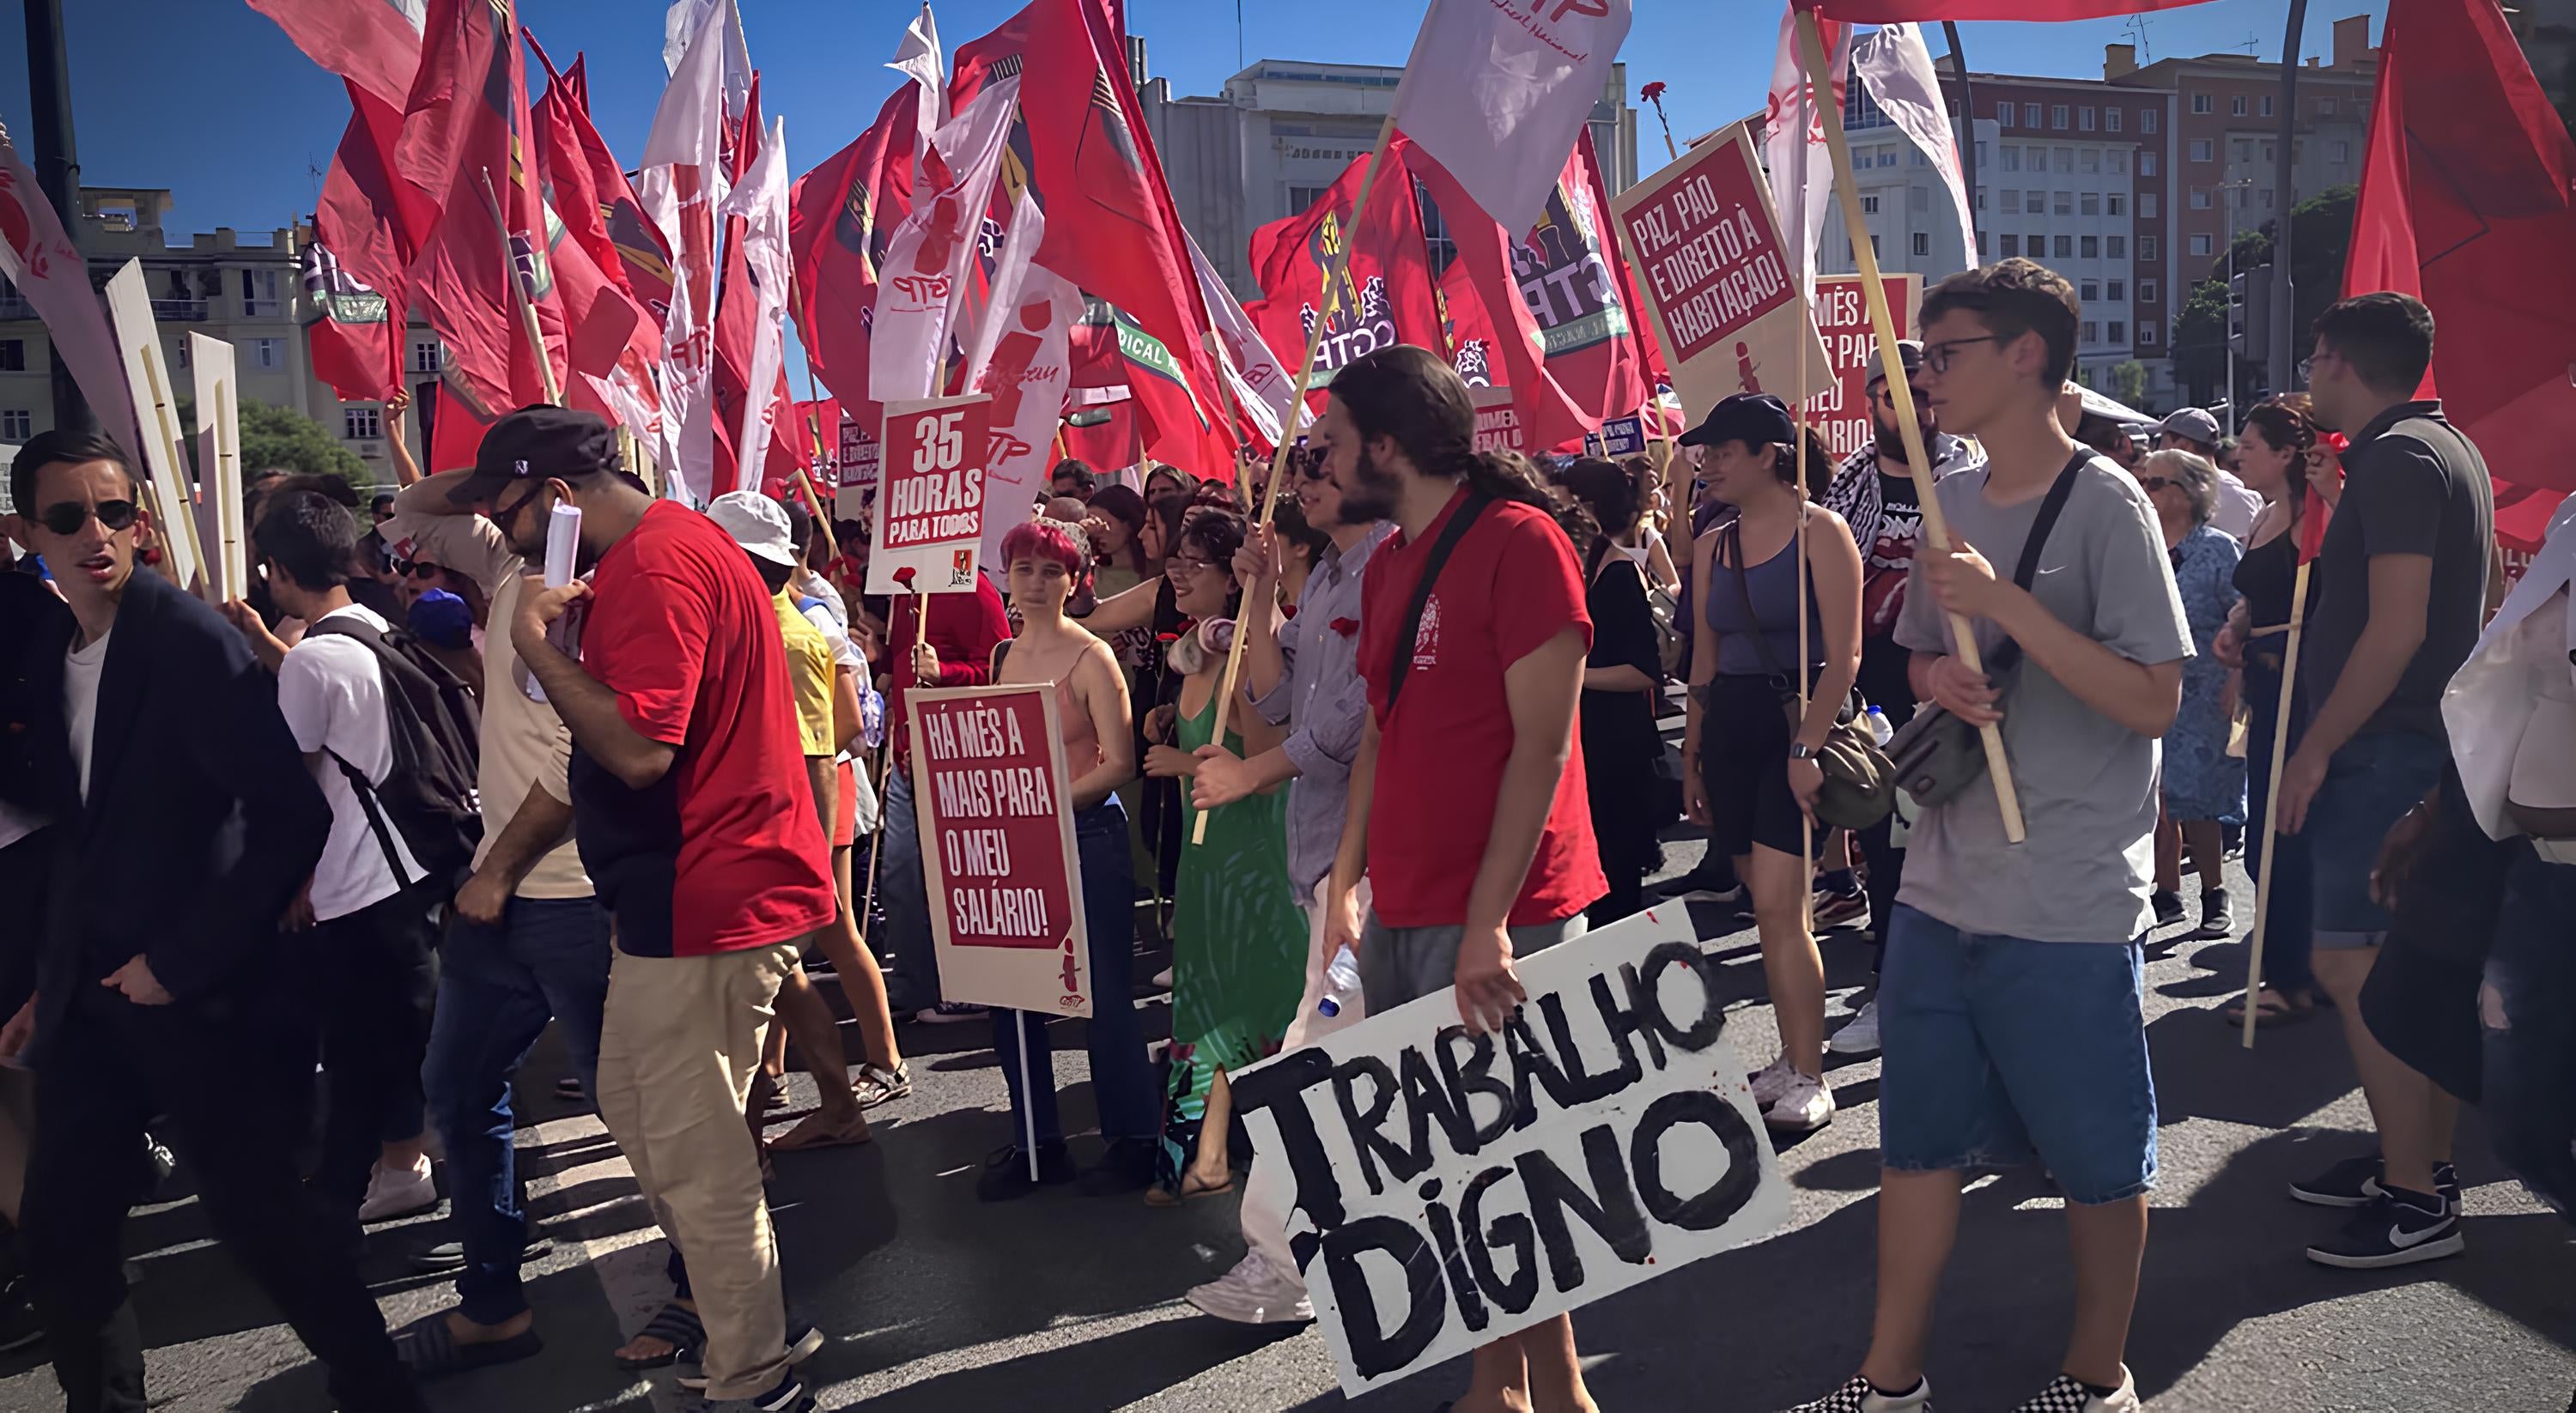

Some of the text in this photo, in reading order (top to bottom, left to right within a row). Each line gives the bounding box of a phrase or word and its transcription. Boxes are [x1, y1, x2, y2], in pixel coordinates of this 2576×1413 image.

[1632, 173, 1719, 258] PAZ, PÃO
[1650, 203, 1762, 303] E DIREITO À
[1668, 250, 1787, 349] HABITAÇÃO!
[913, 411, 965, 473] 35
[890, 468, 982, 519] HORAS
[889, 517, 930, 544] PARA
[925, 700, 1025, 761] HÁ MÊS A
[936, 767, 1054, 818] MAIS PARA
[945, 828, 1011, 877] O MEU
[953, 880, 1049, 937] SALÁRIO!
[1230, 941, 1727, 1230] TRABALHO
